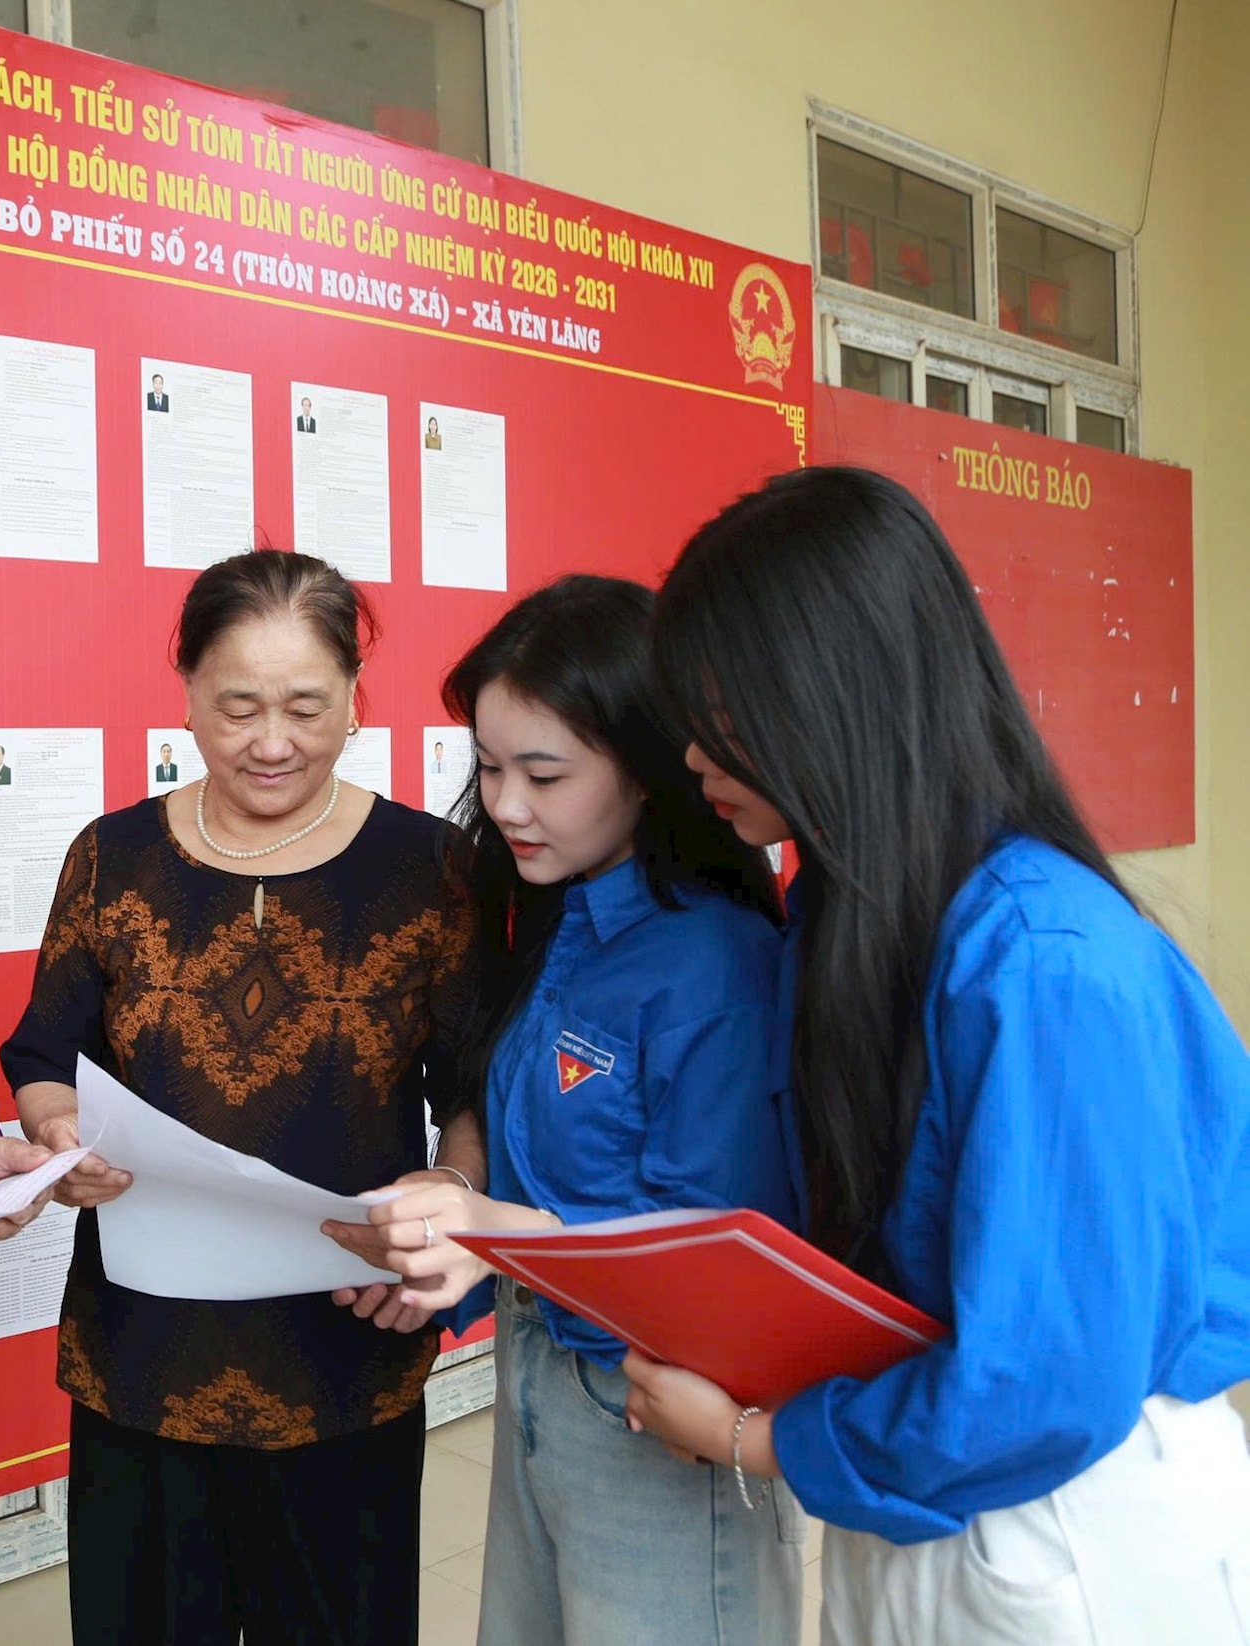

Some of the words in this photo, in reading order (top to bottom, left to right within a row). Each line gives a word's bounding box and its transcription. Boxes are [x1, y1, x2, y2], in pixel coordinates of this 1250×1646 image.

[8, 133, 59, 188] HỘI
[68, 143, 148, 204] ĐỒNG
[156, 170, 232, 223] NHÂN
[239, 188, 293, 237] DÂN
[299, 203, 348, 249] CÁC
[353, 212, 400, 260] CẤP
[405, 232, 475, 281] NHIỆM
[480, 248, 507, 286] KỲ
[512, 258, 558, 299] 2026
[562, 284, 571, 293] -
[575, 275, 617, 313] 2031
[70, 80, 134, 136] TIỂU
[142, 98, 183, 147] SỬ
[186, 113, 244, 165] TÓM
[250, 126, 297, 178] TẮT
[300, 146, 376, 198] NGƯỜI
[380, 161, 427, 211] ỨNG
[432, 176, 463, 220] CỬ
[466, 192, 500, 236] ĐẠI
[506, 198, 549, 244] BIỂU
[554, 215, 603, 259] QUỐC
[607, 230, 636, 273] HỘI
[641, 242, 684, 282] KHÓA
[688, 255, 714, 289] XVI
[50, 210, 143, 258] PHIẾU
[150, 226, 187, 266] SỐ
[194, 239, 226, 275] 24
[231, 248, 315, 294] (THÔN
[320, 267, 404, 311] HOÀNG
[408, 286, 450, 328] XÁ)
[472, 299, 505, 333] XÃ
[507, 306, 547, 343] YÊN
[551, 316, 601, 354] LÃNG
[952, 441, 1040, 501] THÔNG
[1045, 458, 1091, 511] BÁO
